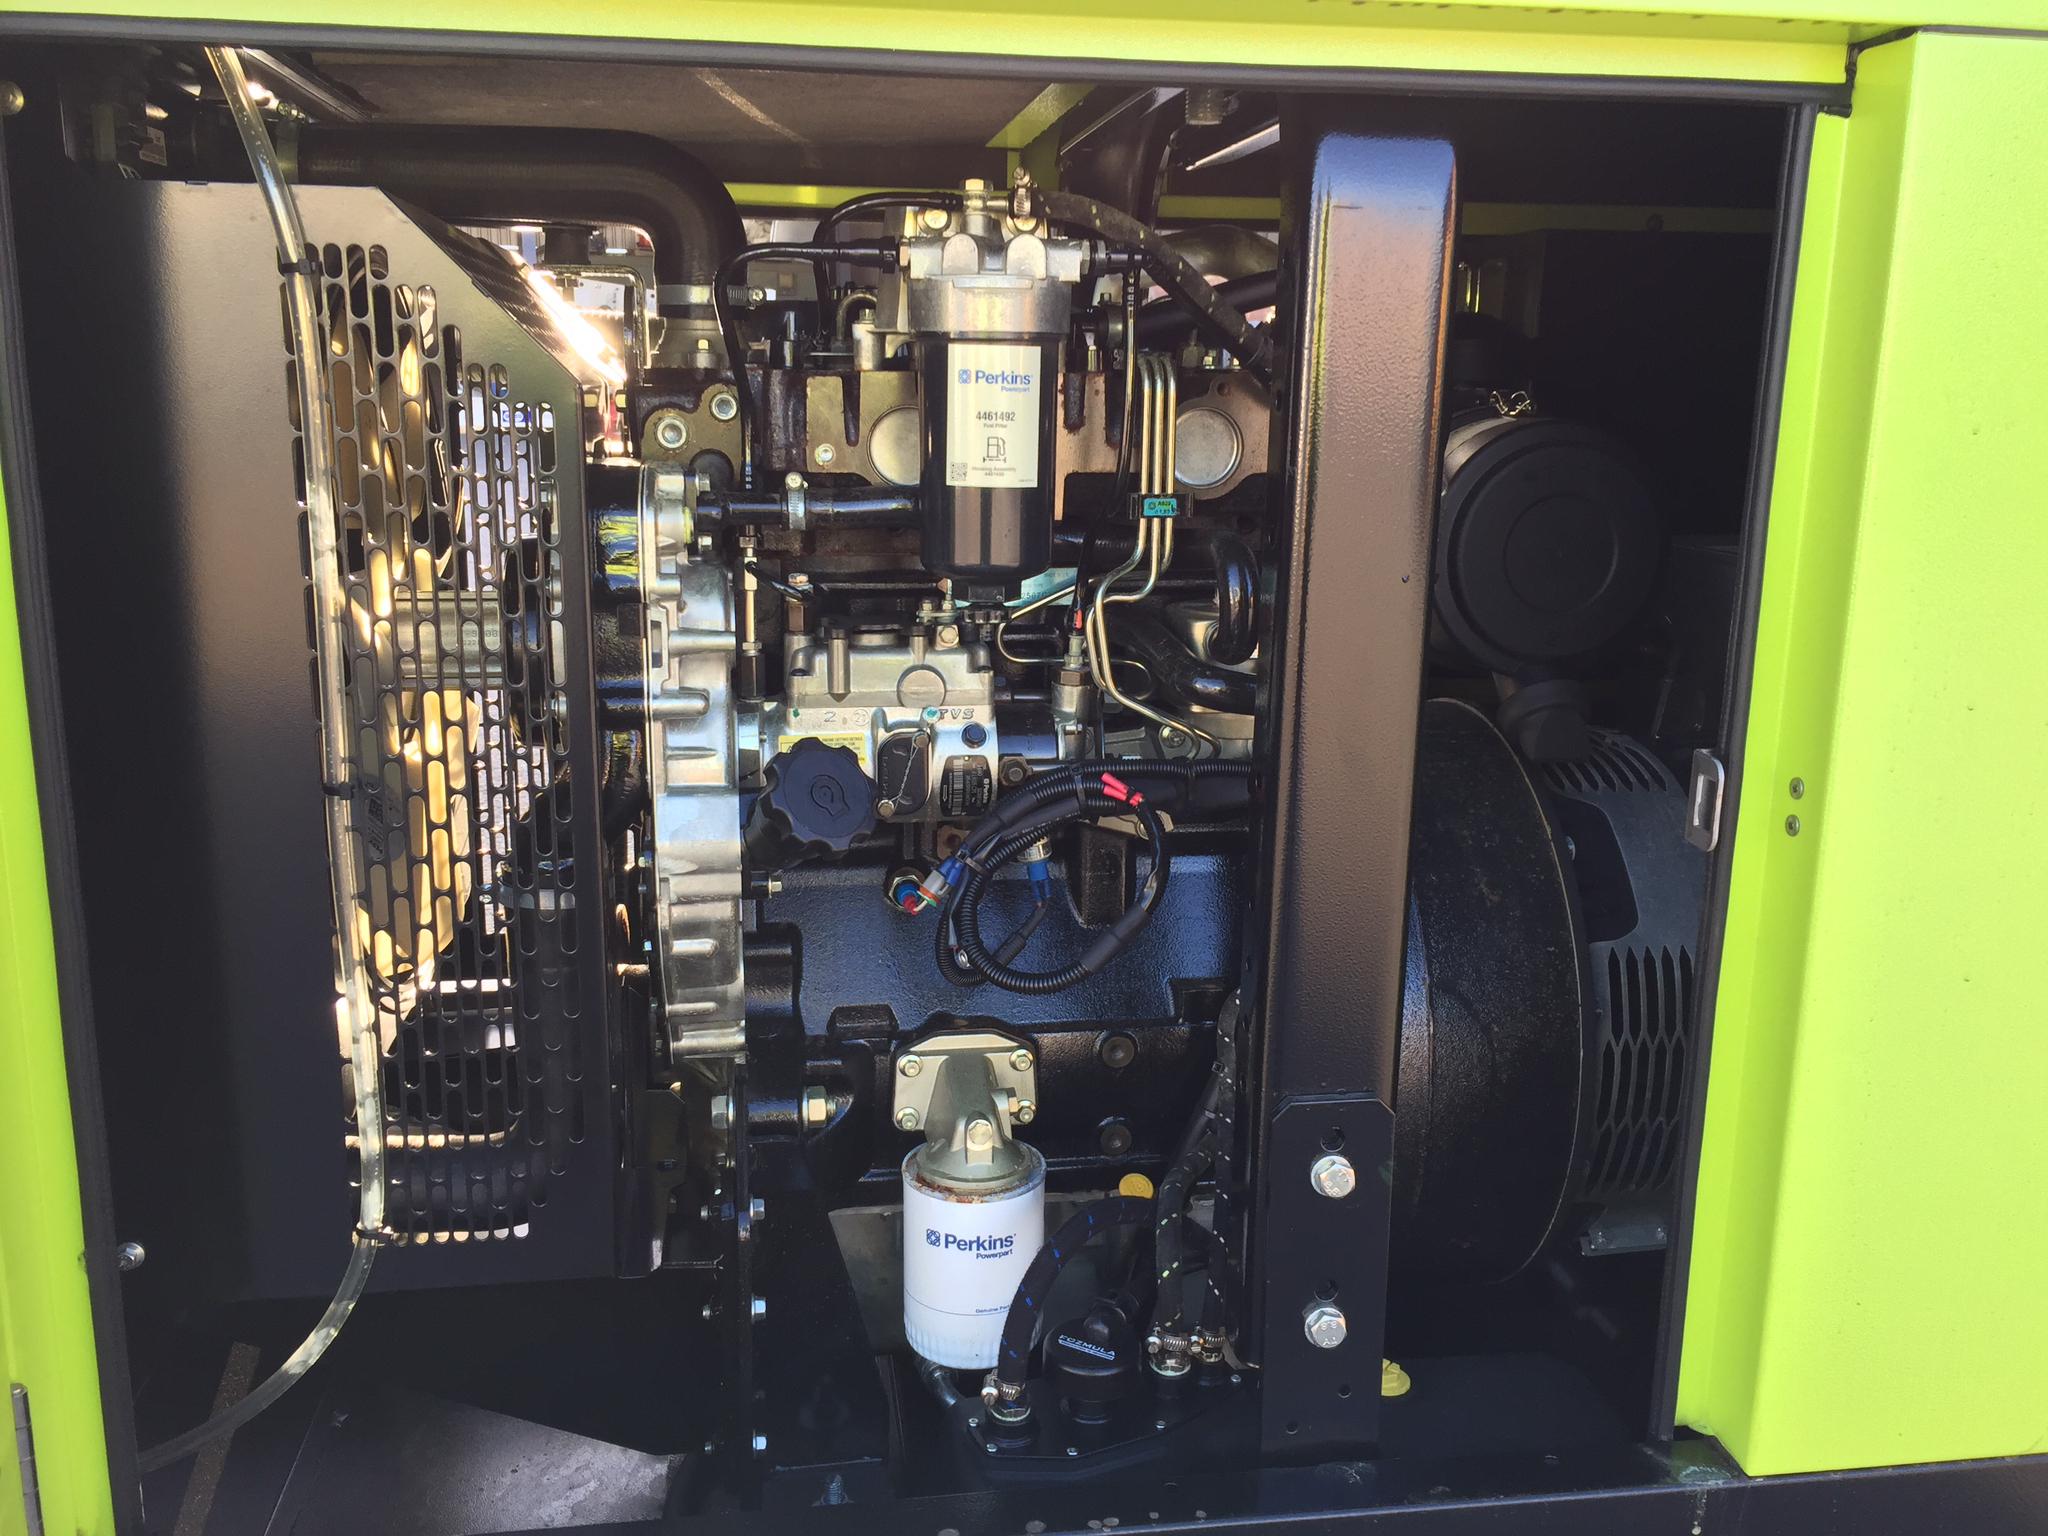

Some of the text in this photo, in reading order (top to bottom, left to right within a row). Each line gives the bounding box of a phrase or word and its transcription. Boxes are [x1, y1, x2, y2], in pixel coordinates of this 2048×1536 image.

[975, 370, 1031, 385] Perkins
[975, 411, 1016, 422] 4461492
[939, 708, 975, 720] TVS
[944, 1233, 1014, 1251] Perkins
[976, 1249, 1013, 1260] Powerpart
[1058, 1334, 1116, 1357] FOZMULA
